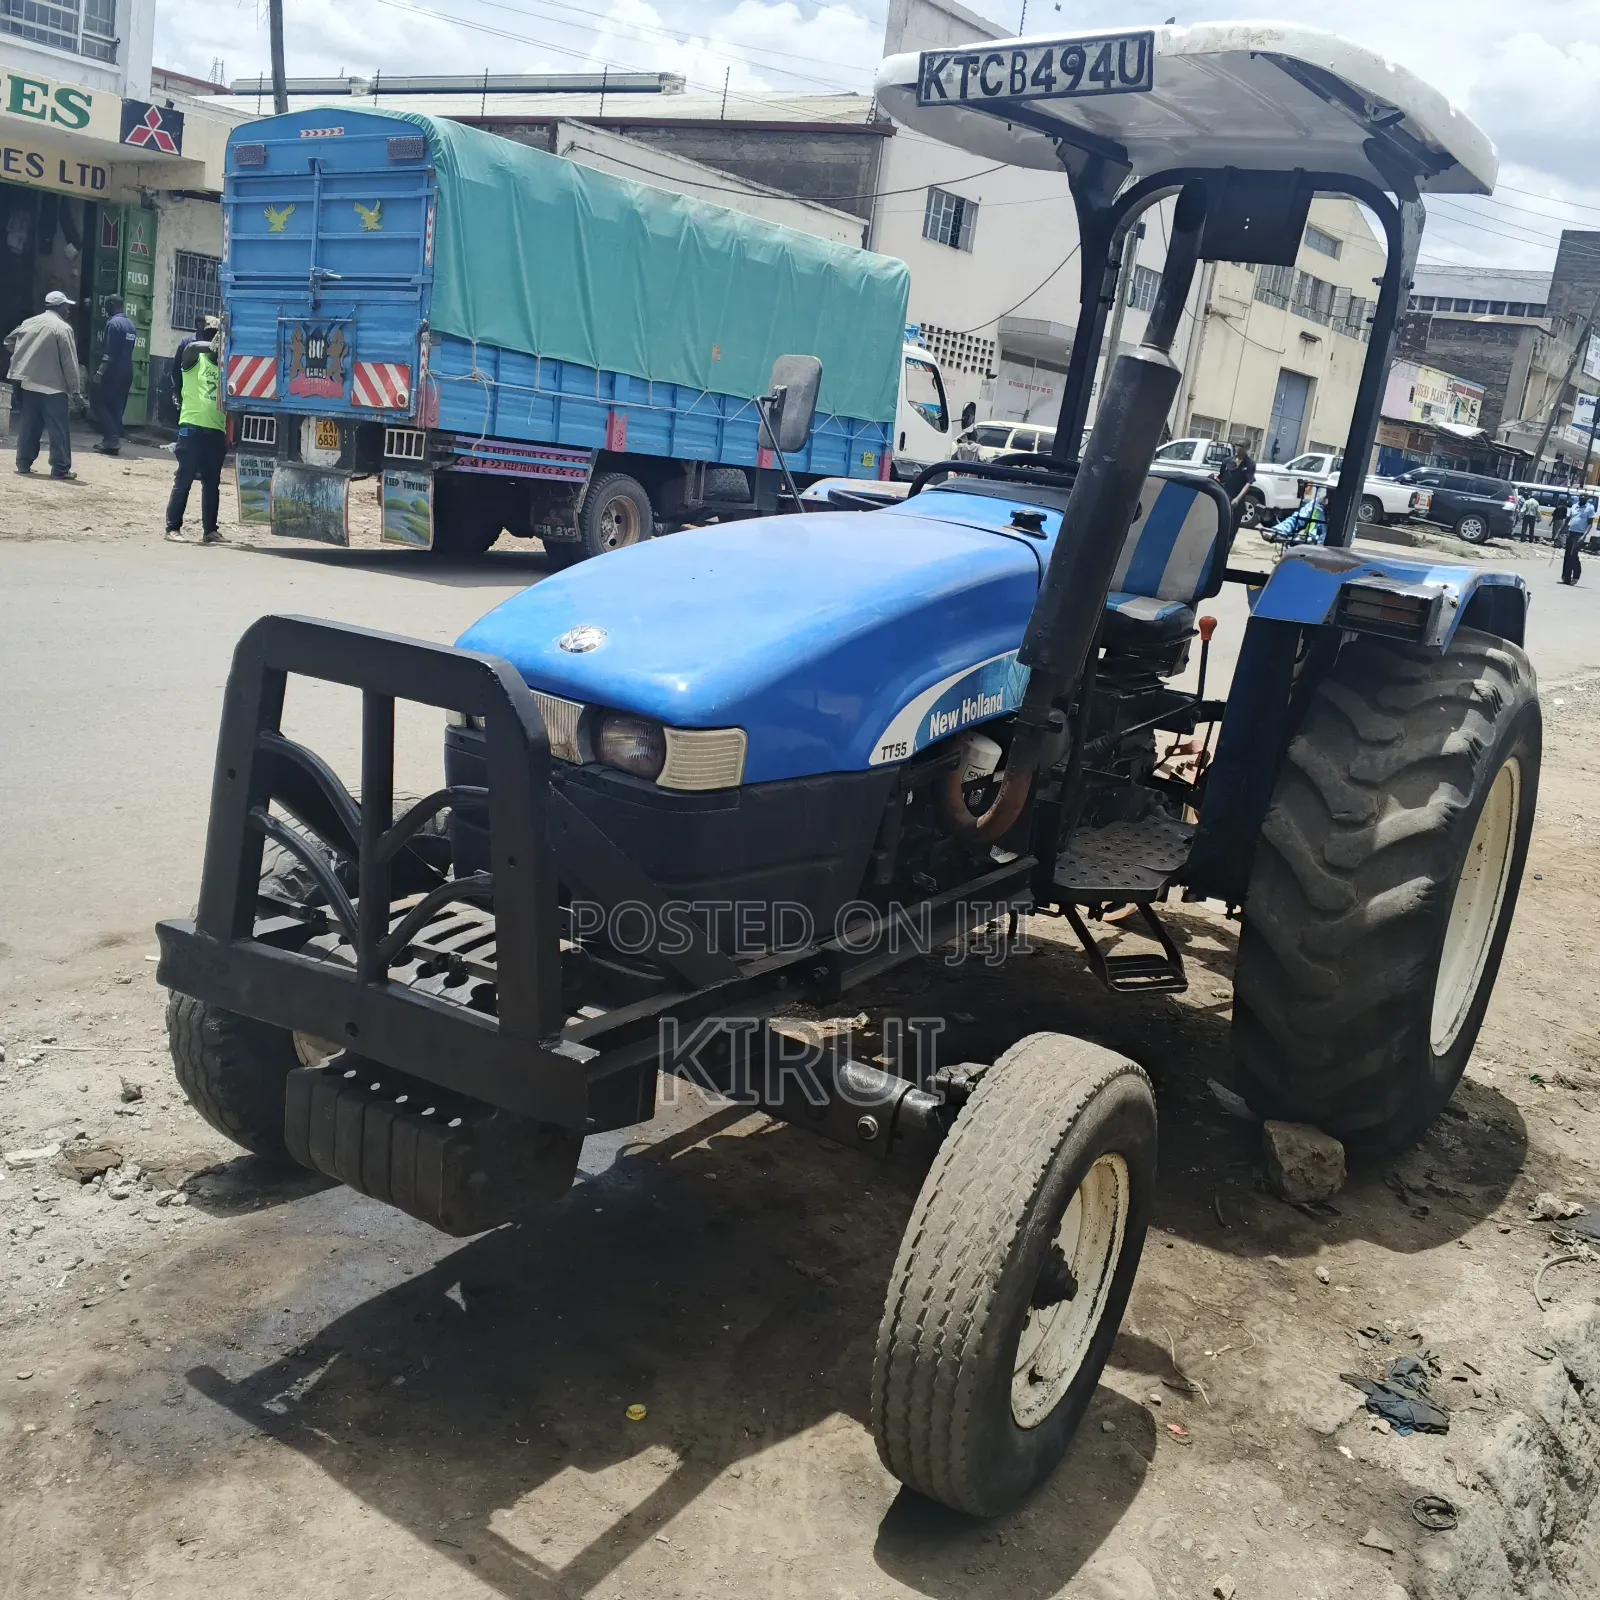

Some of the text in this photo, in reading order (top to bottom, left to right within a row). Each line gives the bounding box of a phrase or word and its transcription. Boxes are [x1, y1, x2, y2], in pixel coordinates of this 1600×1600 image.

[923, 39, 1146, 100] KTCB494U
[0, 74, 92, 130] ES
[0, 147, 106, 191] ES LTD
[127, 271, 149, 286] FUSO
[125, 302, 137, 317] FH
[384, 476, 427, 492] KEEP TRYING
[929, 687, 1005, 740] New Holland
[881, 741, 907, 761] TT55
